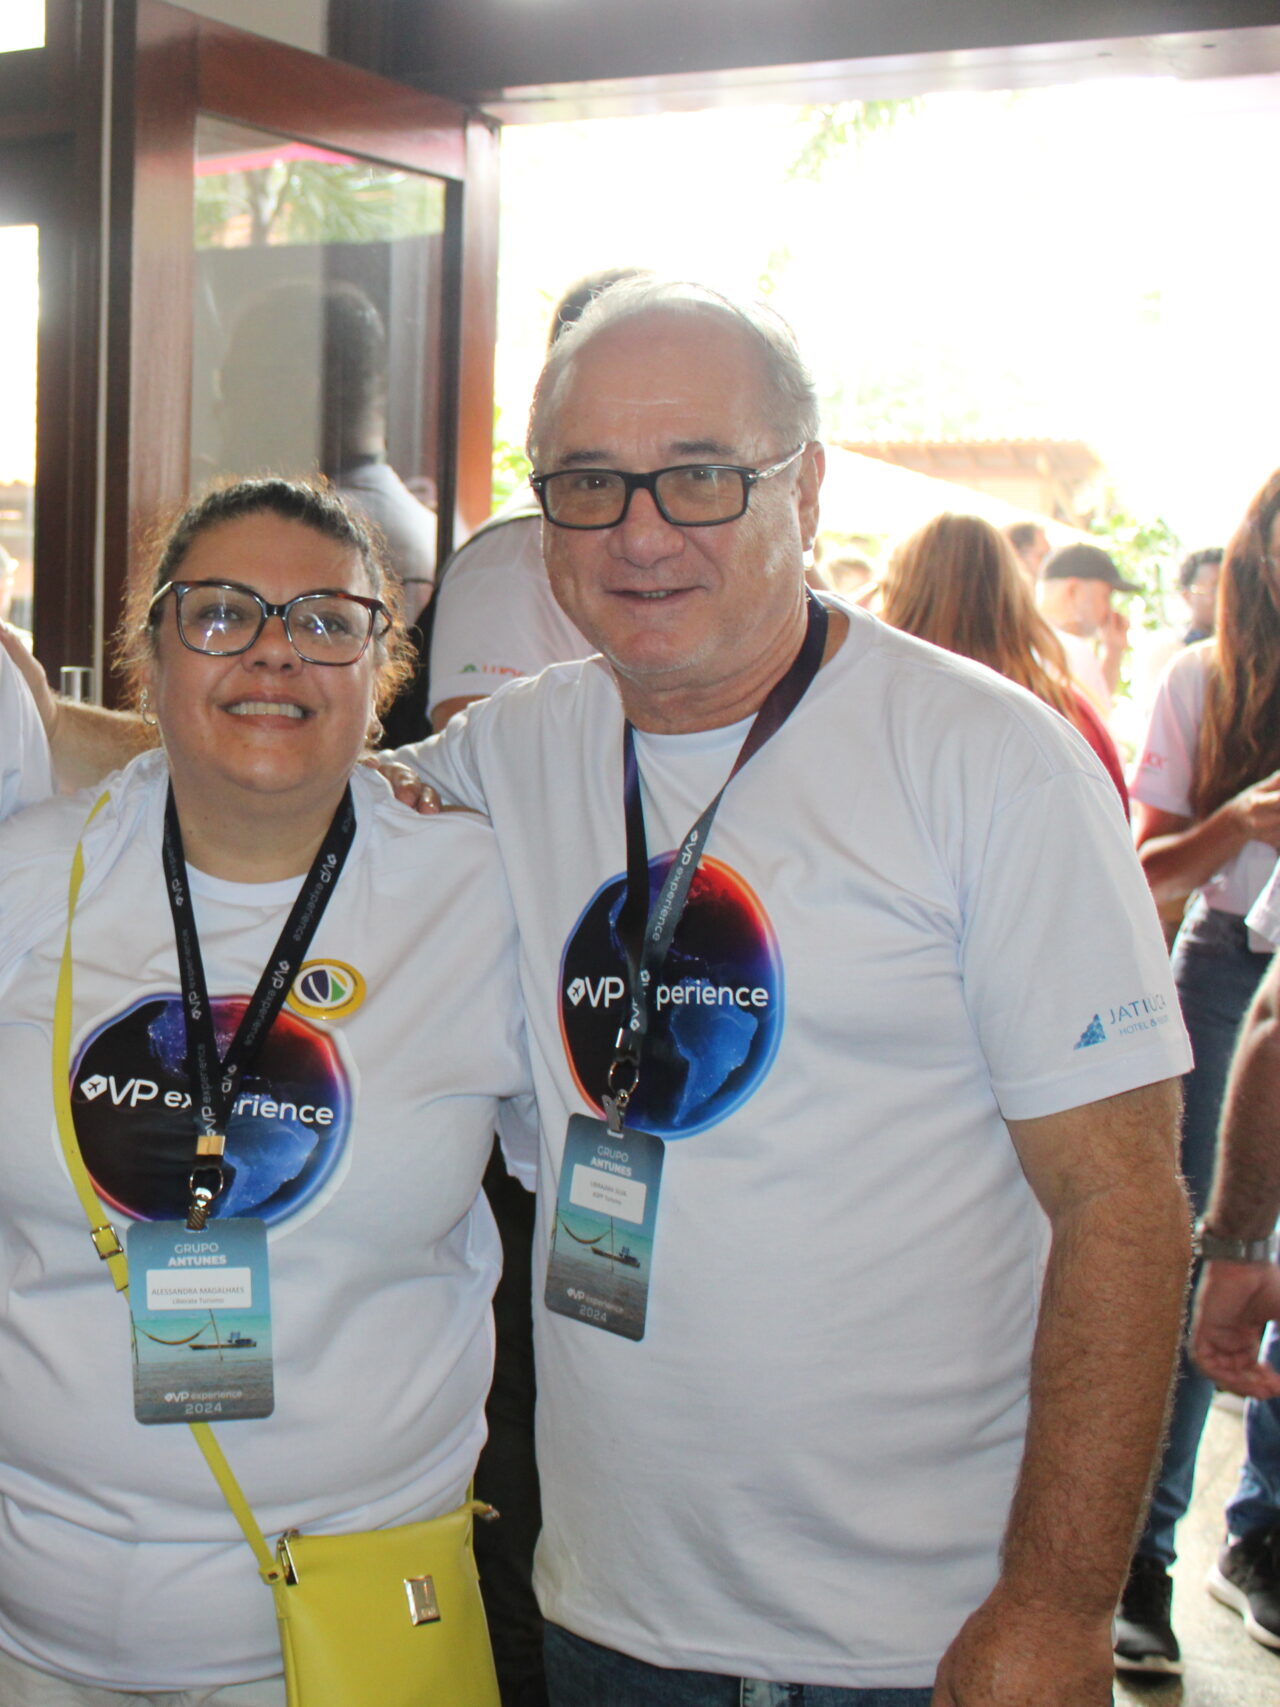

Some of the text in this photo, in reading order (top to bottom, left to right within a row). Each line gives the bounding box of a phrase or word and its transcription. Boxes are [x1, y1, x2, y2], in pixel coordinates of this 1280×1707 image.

[652, 866, 684, 941] experience
[584, 976, 769, 1012] VP perience
[108, 1075, 335, 1126] VP exrience
[596, 1145, 629, 1163] GRUPO
[590, 1156, 632, 1177] ANTUNES
[174, 1242, 219, 1254] GRUPO
[167, 1254, 227, 1267] ANTUNES
[579, 1304, 608, 1323] 2024
[184, 1402, 223, 1414] 2024
